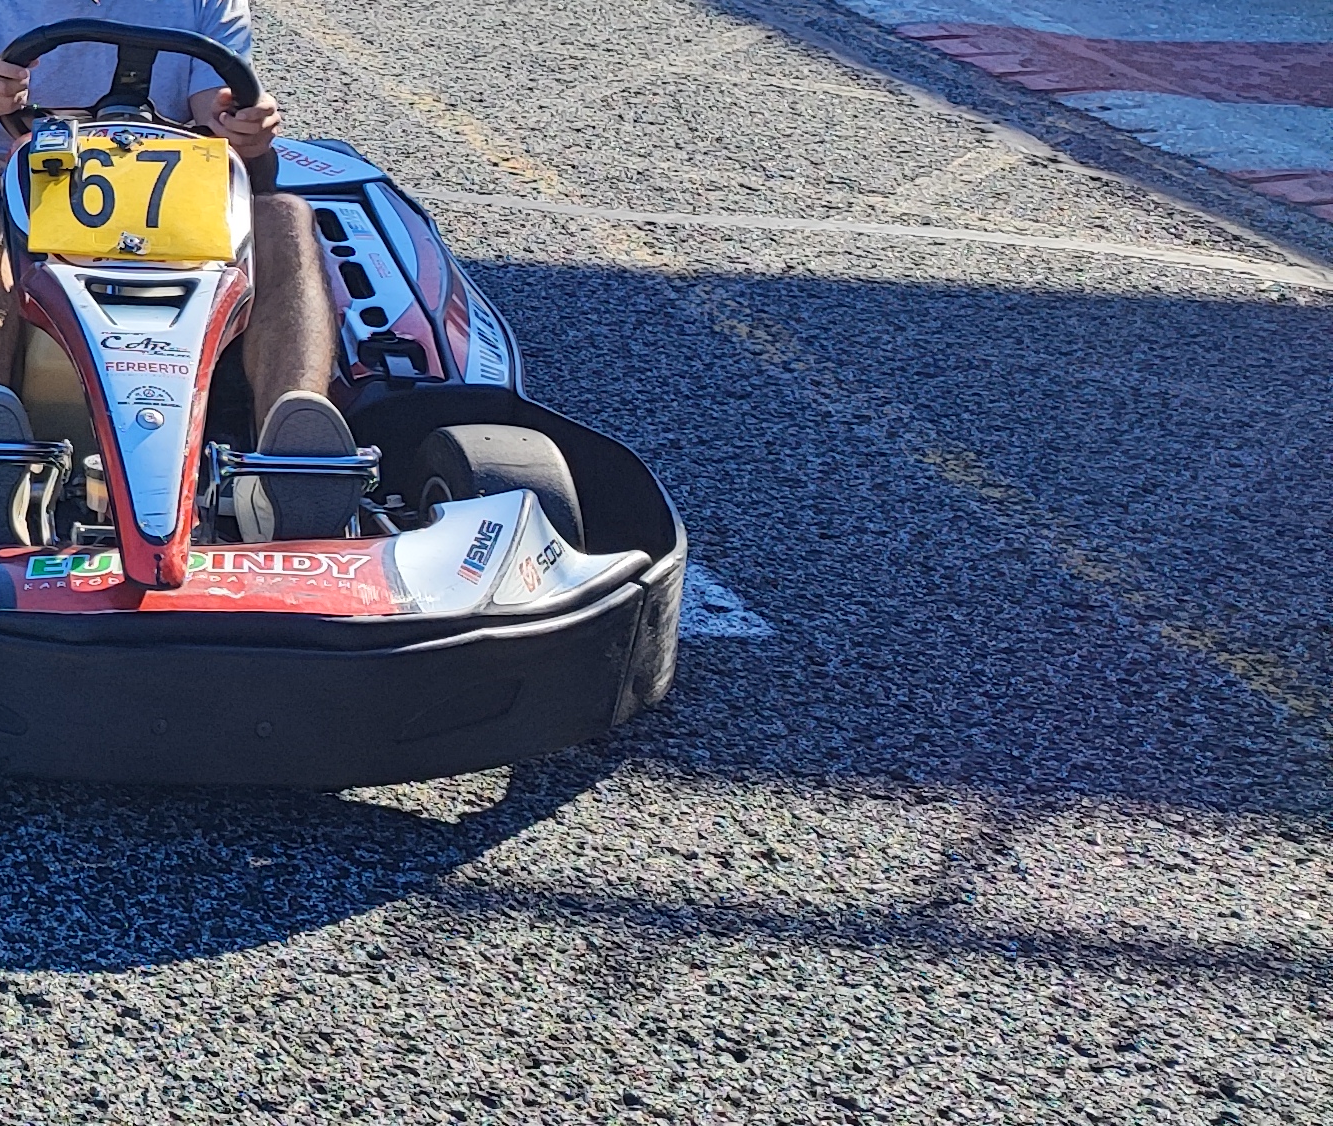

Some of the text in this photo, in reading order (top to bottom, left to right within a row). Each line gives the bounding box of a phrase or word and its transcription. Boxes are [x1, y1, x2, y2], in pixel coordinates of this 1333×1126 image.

[68, 148, 182, 229] 67
[104, 361, 189, 375] FERBERTO
[466, 519, 504, 566] SWS
[25, 551, 373, 580] EUINDY
